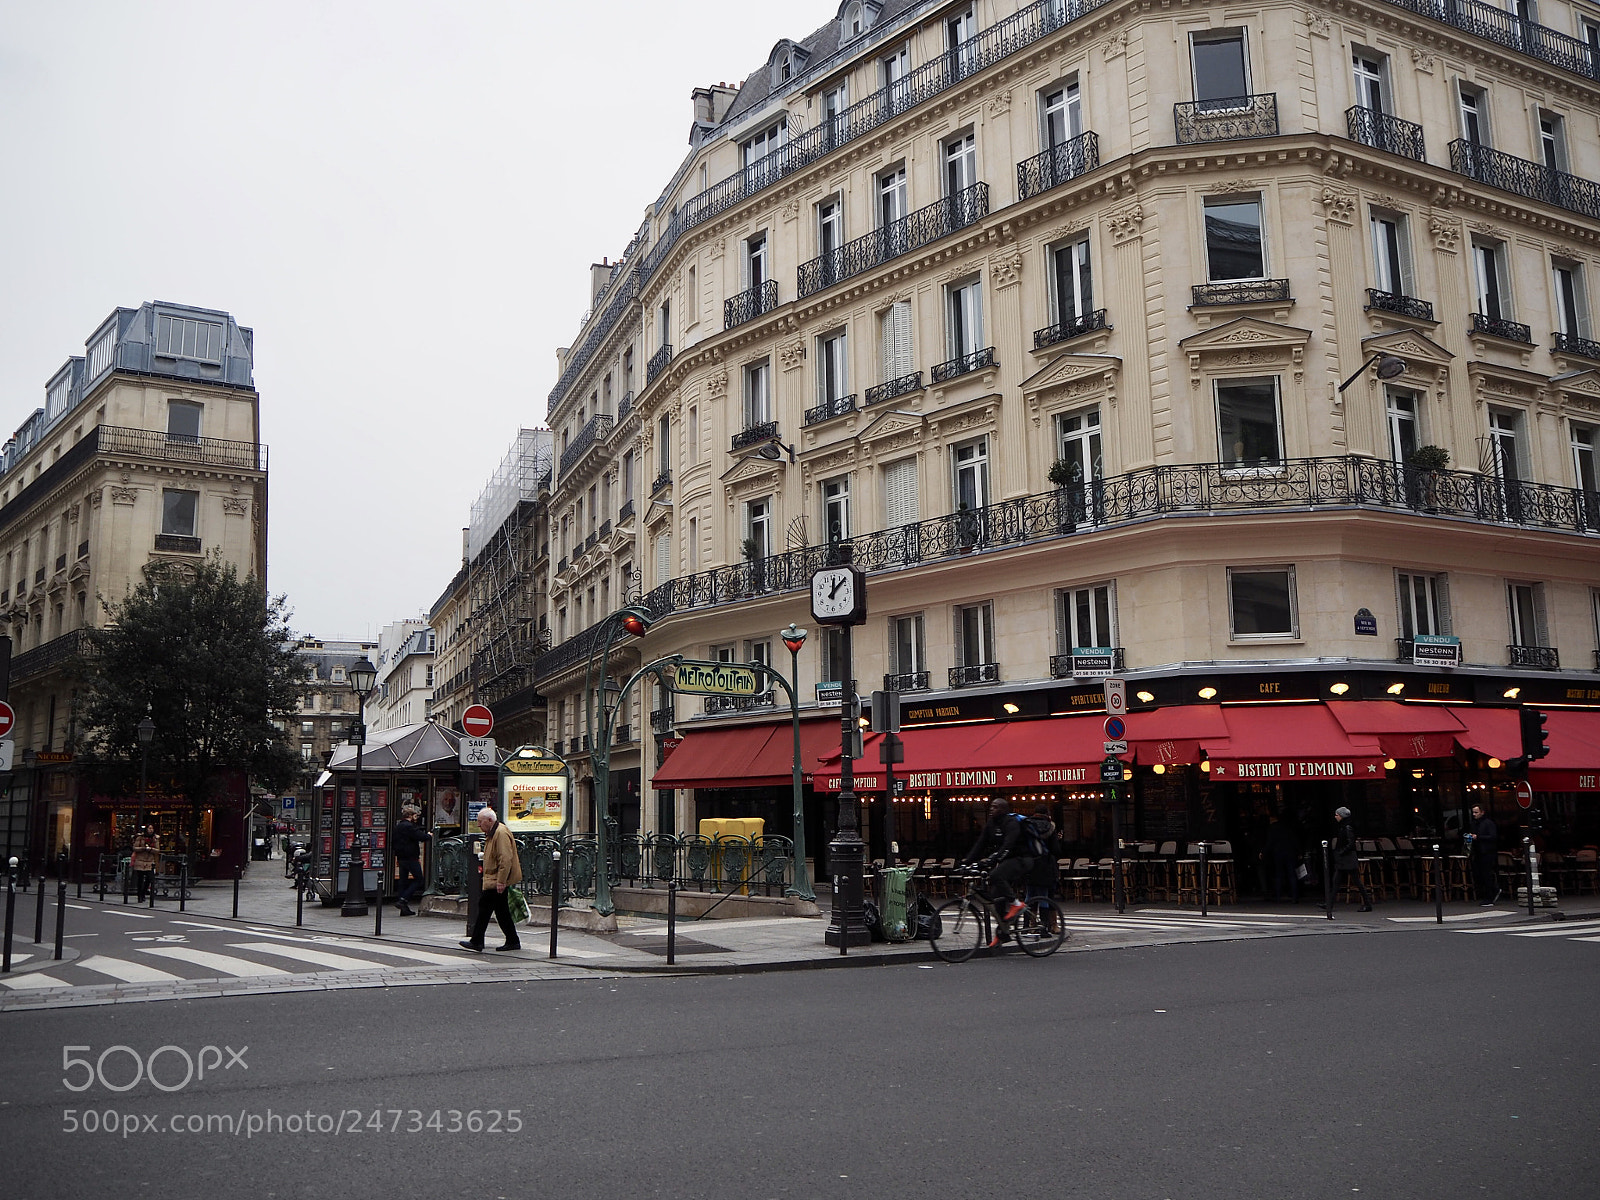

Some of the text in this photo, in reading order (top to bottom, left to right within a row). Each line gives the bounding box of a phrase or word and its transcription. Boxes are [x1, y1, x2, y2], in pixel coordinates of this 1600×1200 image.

[678, 666, 754, 691] METROPOLITAIN
[1259, 682, 1280, 694] CAFE
[38, 753, 70, 761] NICOLAS
[1038, 768, 1086, 782] RESTAURANT
[1238, 762, 1354, 777] BISTROT D'EDMOND
[909, 770, 997, 788] BISTROT D'EDMOND
[1579, 775, 1596, 788] CAFE
[285, 799, 292, 808] P
